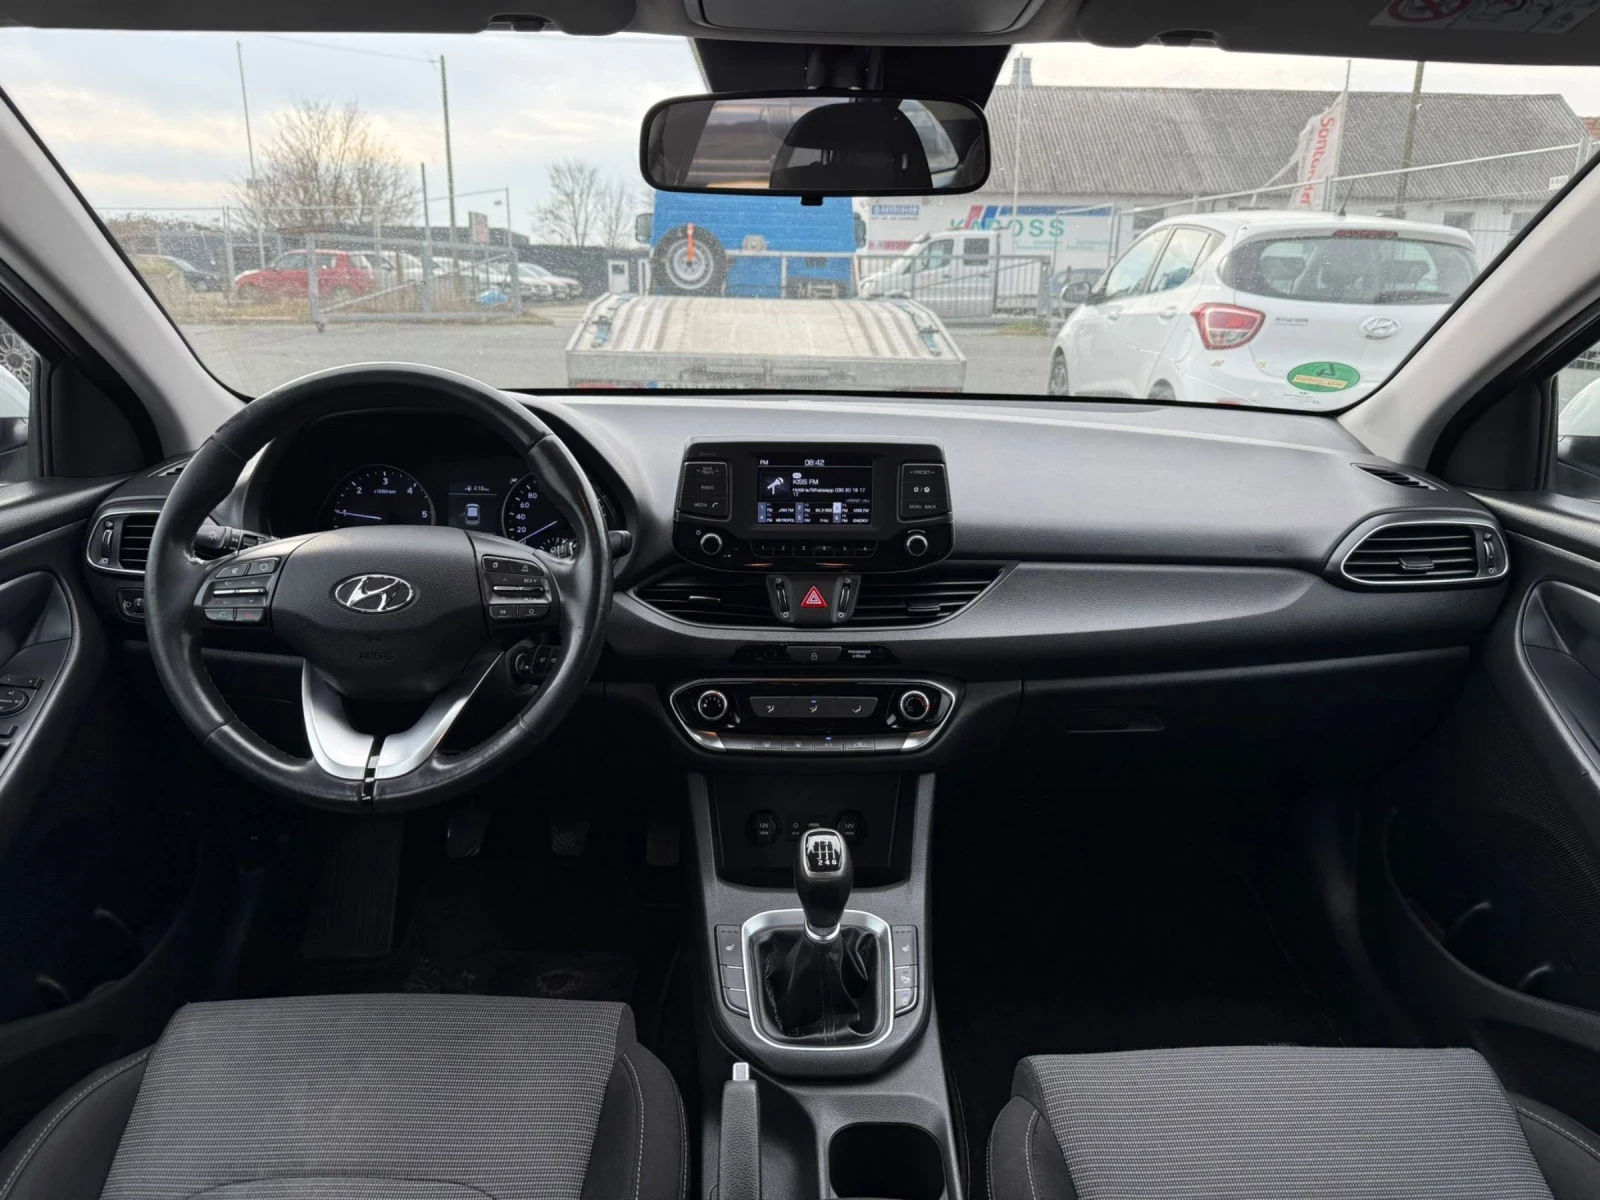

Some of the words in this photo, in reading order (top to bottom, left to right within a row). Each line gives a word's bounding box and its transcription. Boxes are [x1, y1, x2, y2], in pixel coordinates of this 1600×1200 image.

[804, 459, 825, 467] 08:42
[383, 477, 388, 485] 3
[356, 486, 362, 494] 2
[527, 492, 538, 500] 80
